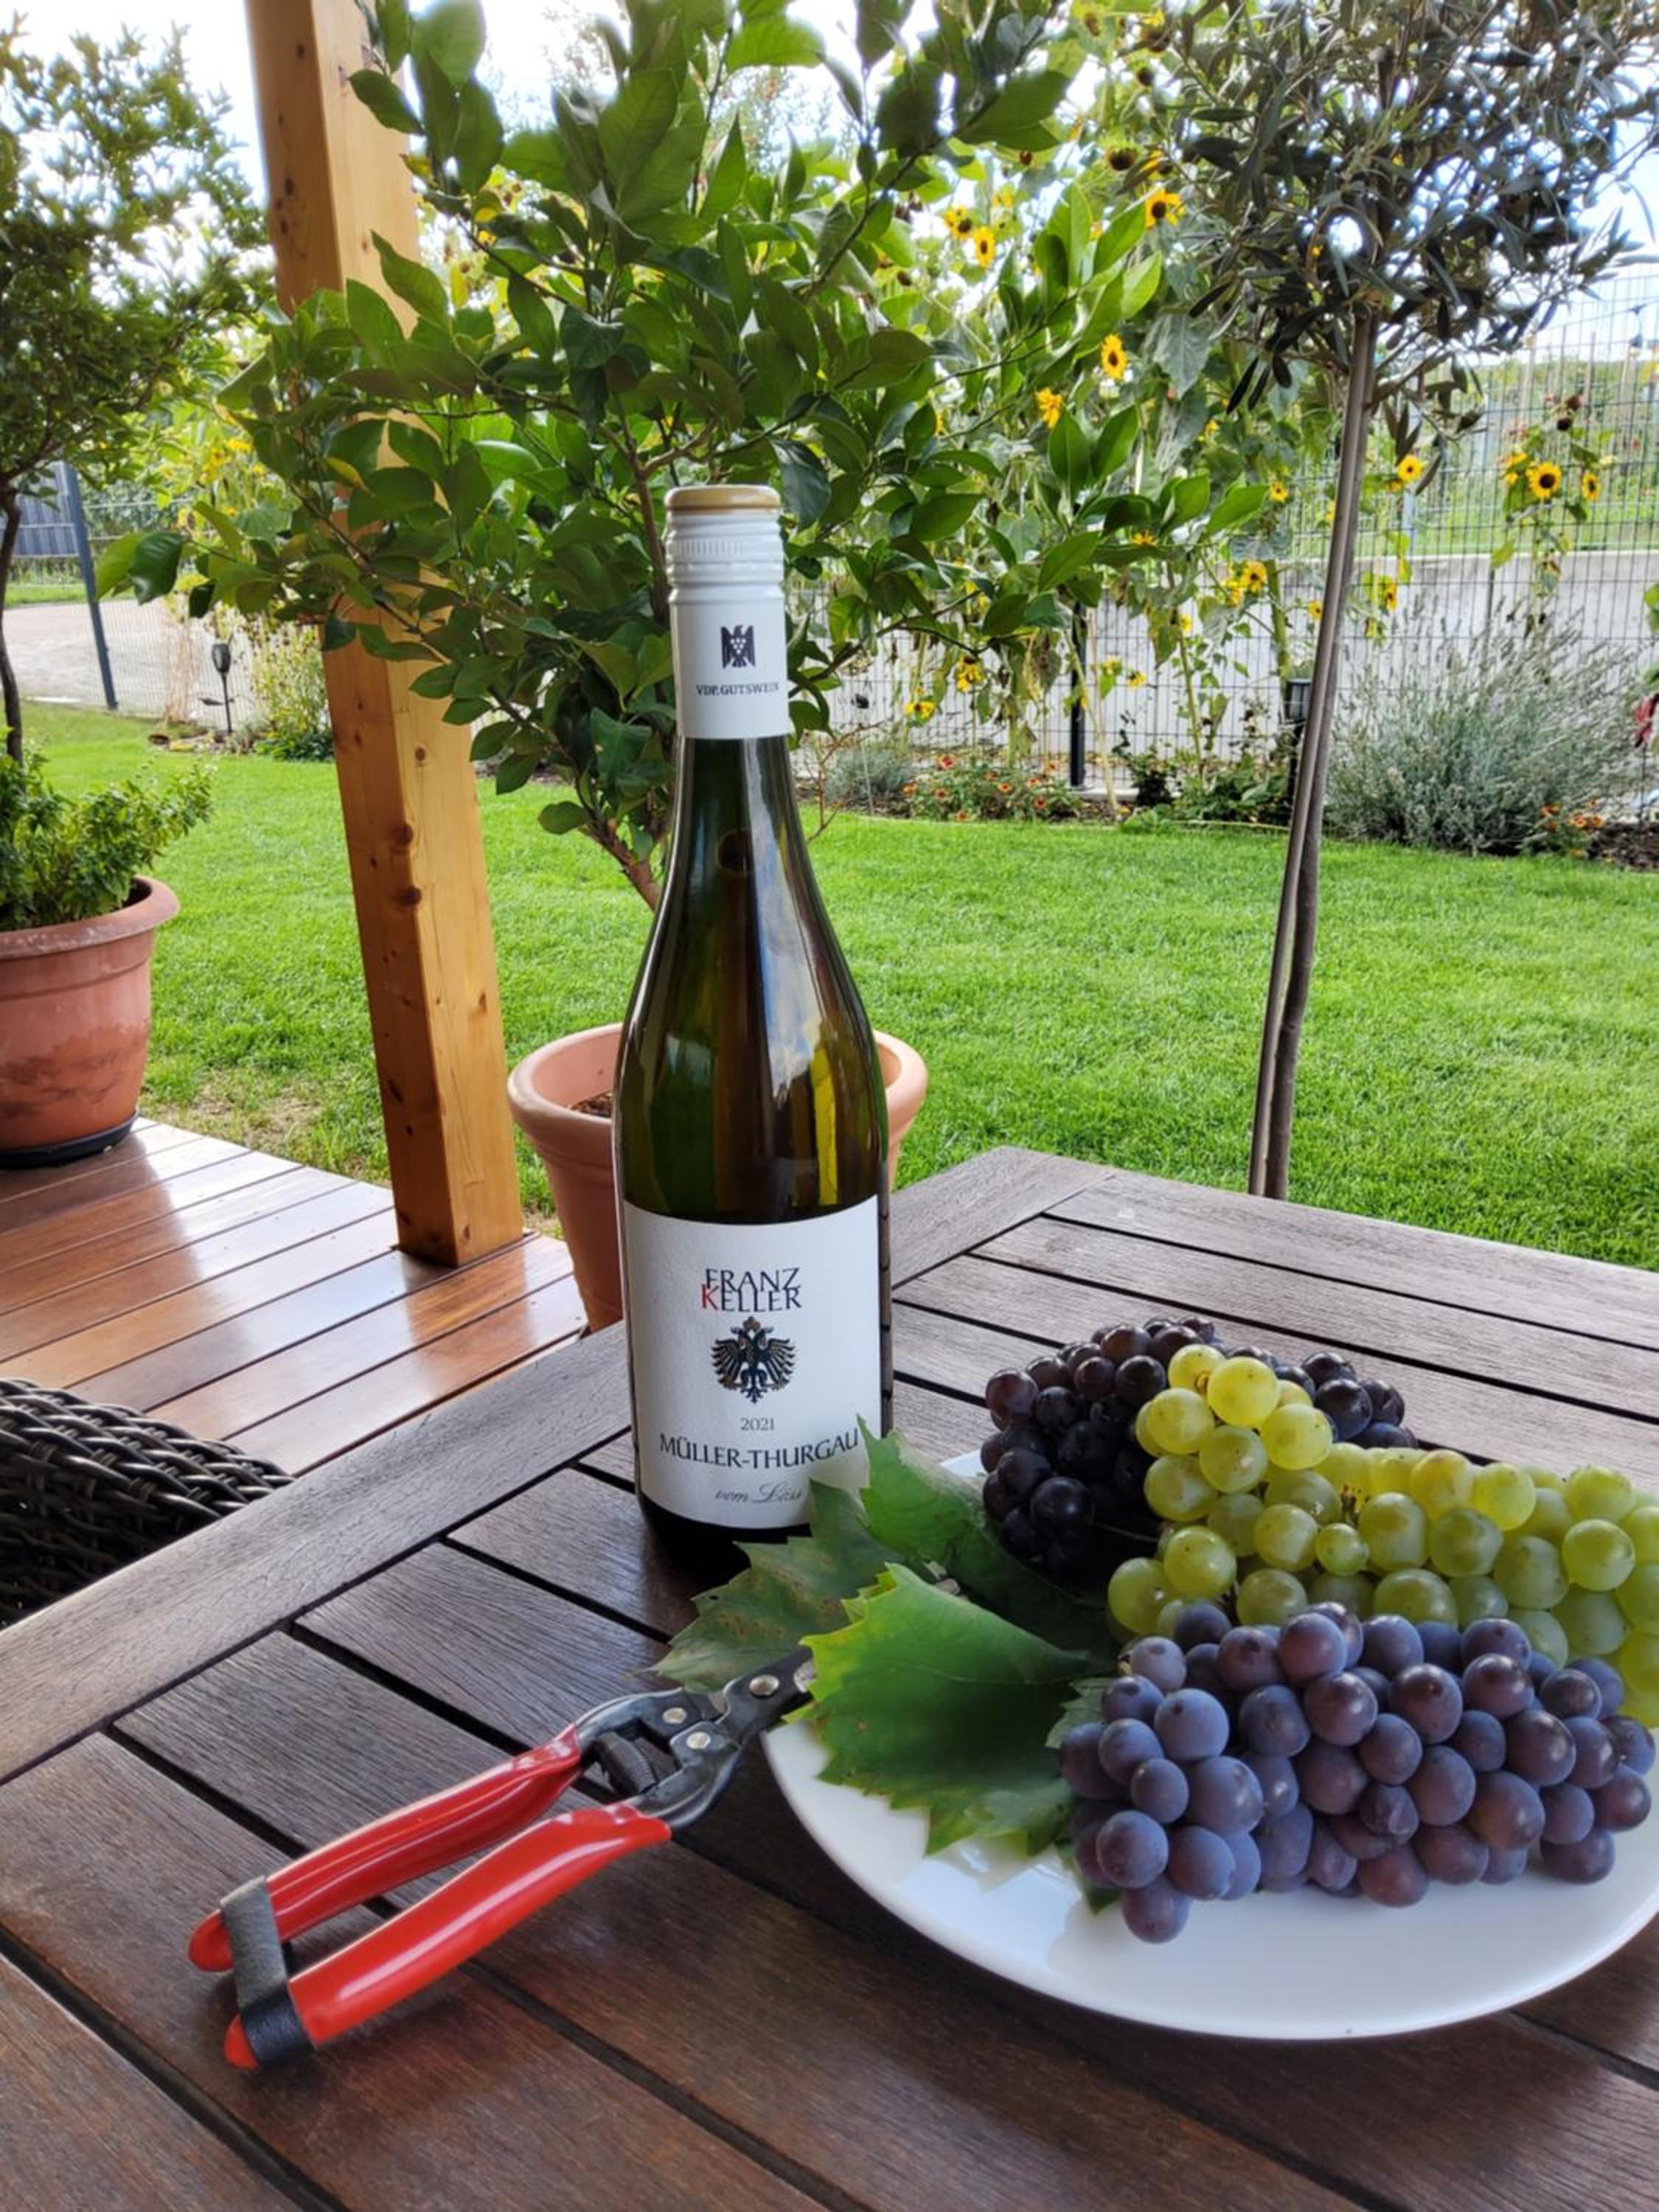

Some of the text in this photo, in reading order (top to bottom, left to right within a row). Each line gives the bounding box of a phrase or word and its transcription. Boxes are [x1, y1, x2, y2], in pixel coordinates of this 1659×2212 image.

[706, 1267, 801, 1293] FRANZ
[701, 1283, 802, 1312] KELLER
[740, 1417, 775, 1431] 2021
[660, 1427, 859, 1469] MÜLLER-THURGAU
[714, 1489, 749, 1503] vom
